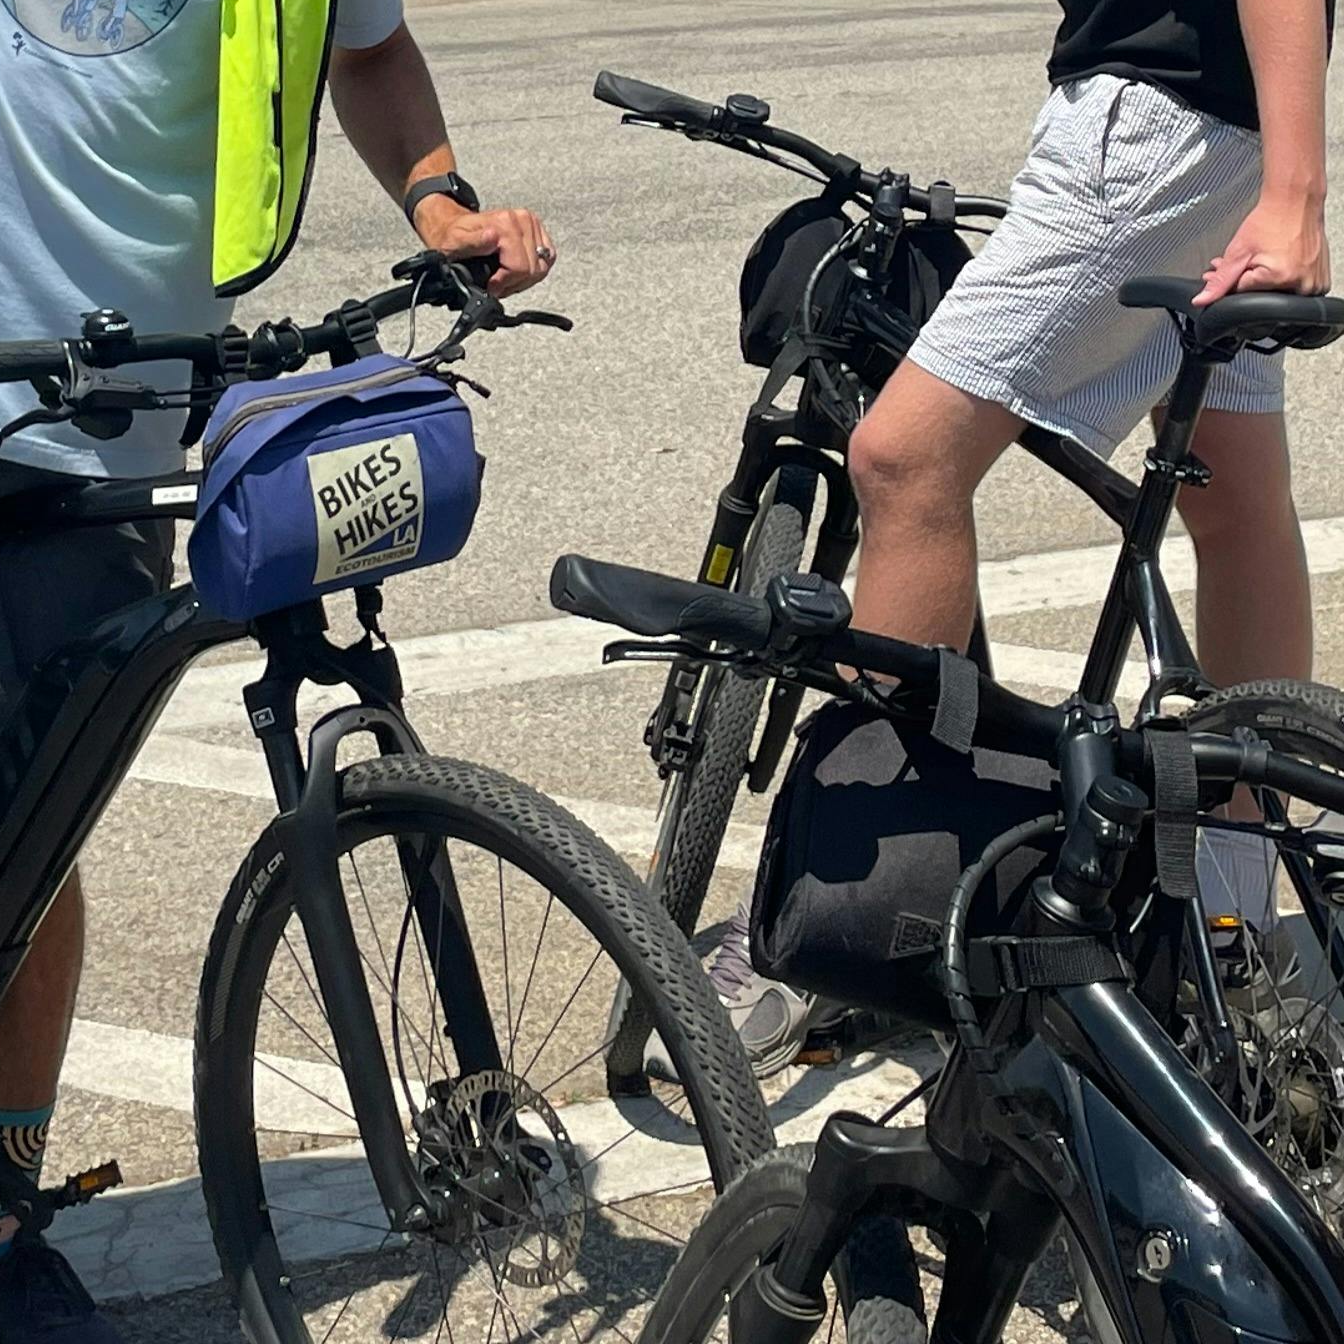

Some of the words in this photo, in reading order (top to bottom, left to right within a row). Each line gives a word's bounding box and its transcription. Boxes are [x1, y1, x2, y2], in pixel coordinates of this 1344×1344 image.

[317, 443, 402, 519] BIKES
[333, 481, 419, 555] HIKES
[392, 524, 416, 547] LA
